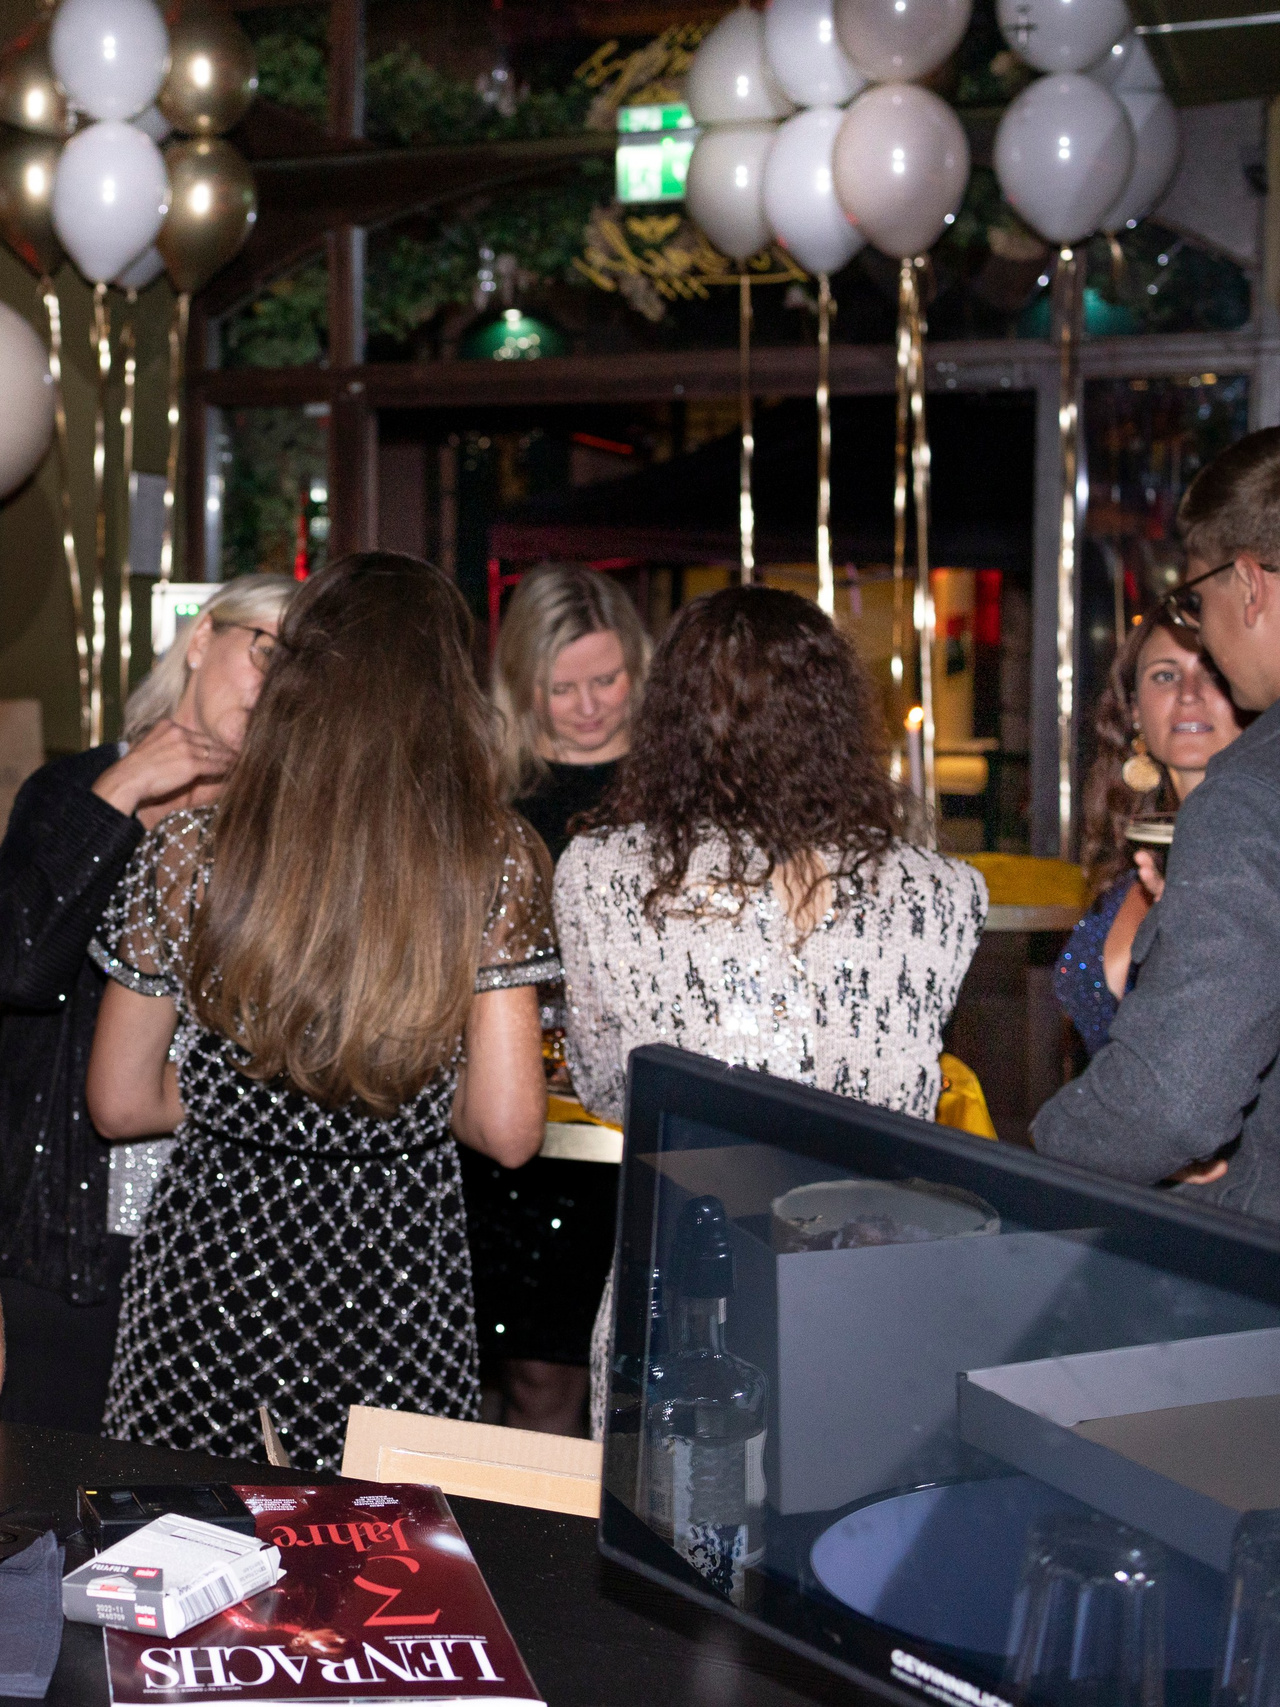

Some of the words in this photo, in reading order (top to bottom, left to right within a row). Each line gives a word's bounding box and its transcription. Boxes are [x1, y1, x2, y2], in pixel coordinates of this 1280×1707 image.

[270, 1517, 415, 1552] Jahre
[91, 1564, 130, 1573] FUJIFILM
[353, 1555, 441, 1626] 3
